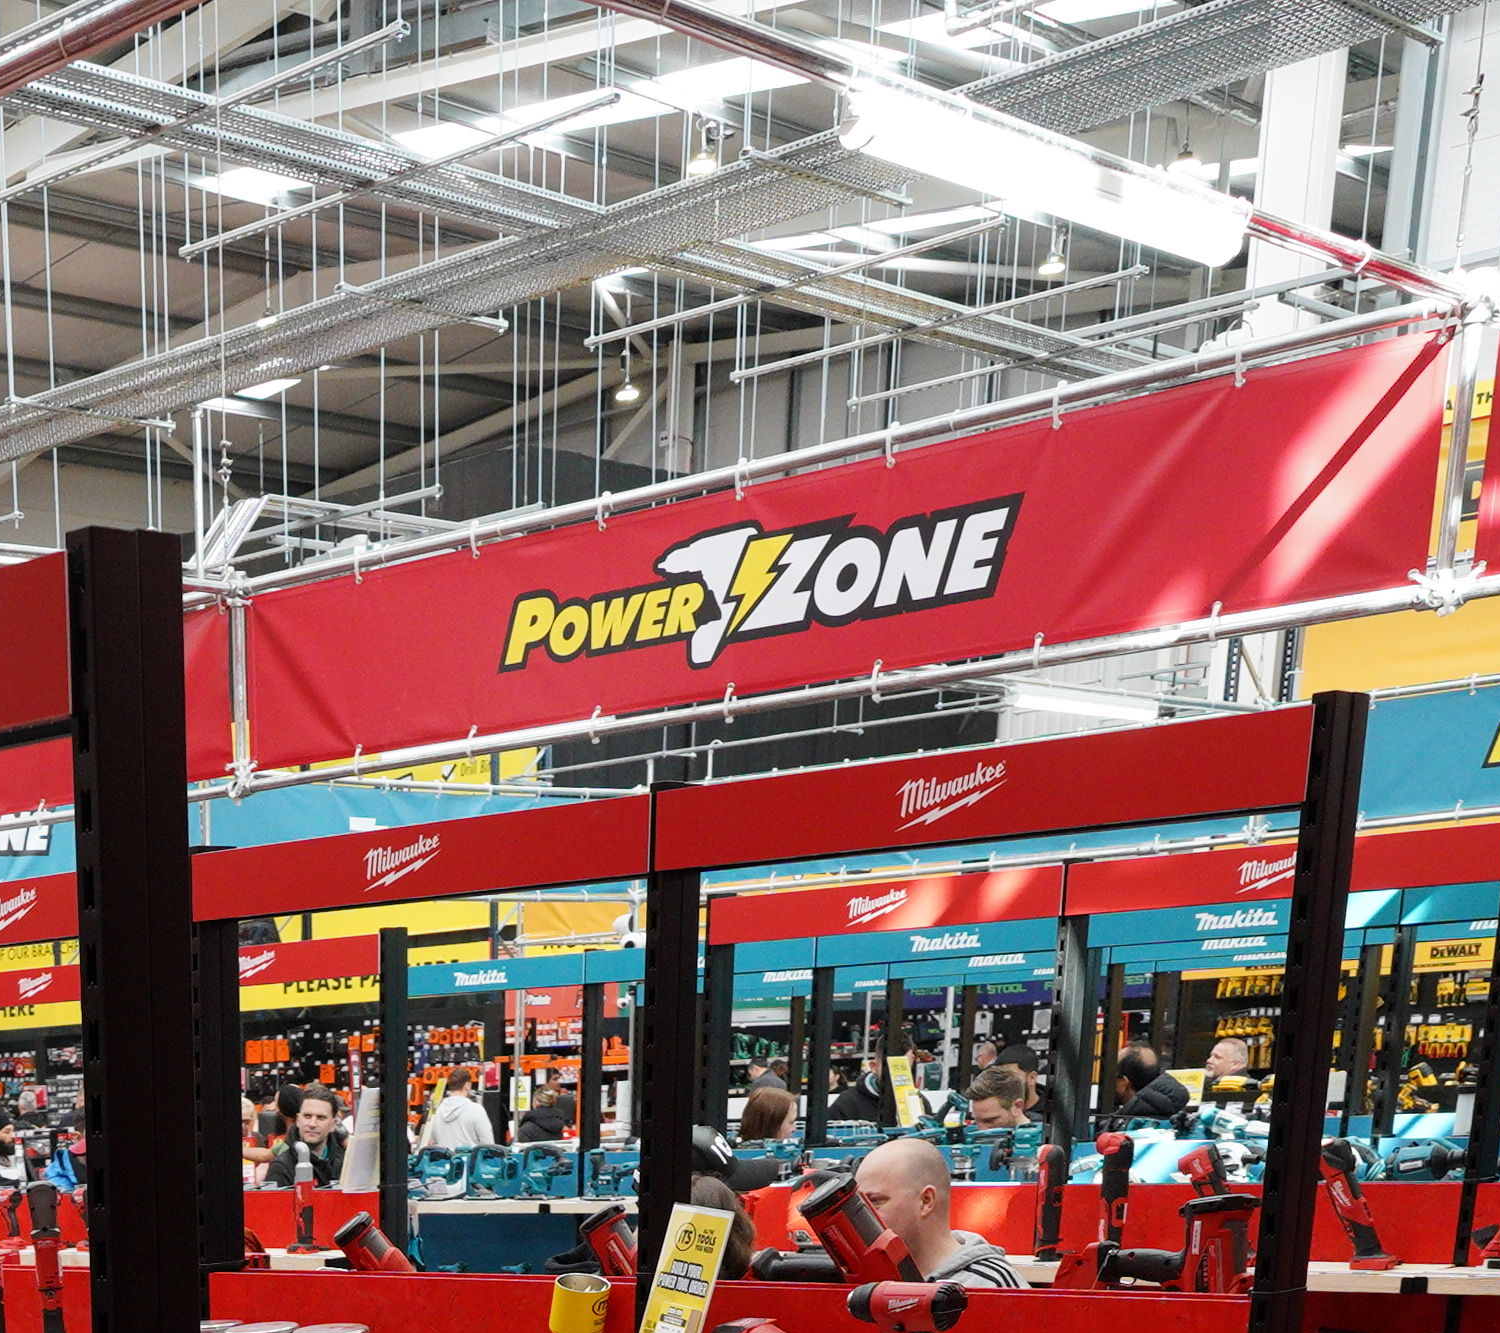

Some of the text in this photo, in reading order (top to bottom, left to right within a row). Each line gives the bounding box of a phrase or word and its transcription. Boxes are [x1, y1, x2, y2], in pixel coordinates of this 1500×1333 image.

[506, 507, 1012, 668] POWER ZONE
[896, 760, 1006, 818] Milwaukee
[364, 833, 440, 881] Milwaukee
[846, 889, 908, 918] Milwaukee
[1196, 910, 1278, 932] makita
[910, 931, 980, 953] makita
[7, 947, 30, 961] OUR
[17, 973, 53, 994] Milwaukee
[453, 969, 507, 987] makita
[678, 1228, 695, 1245] ITS
